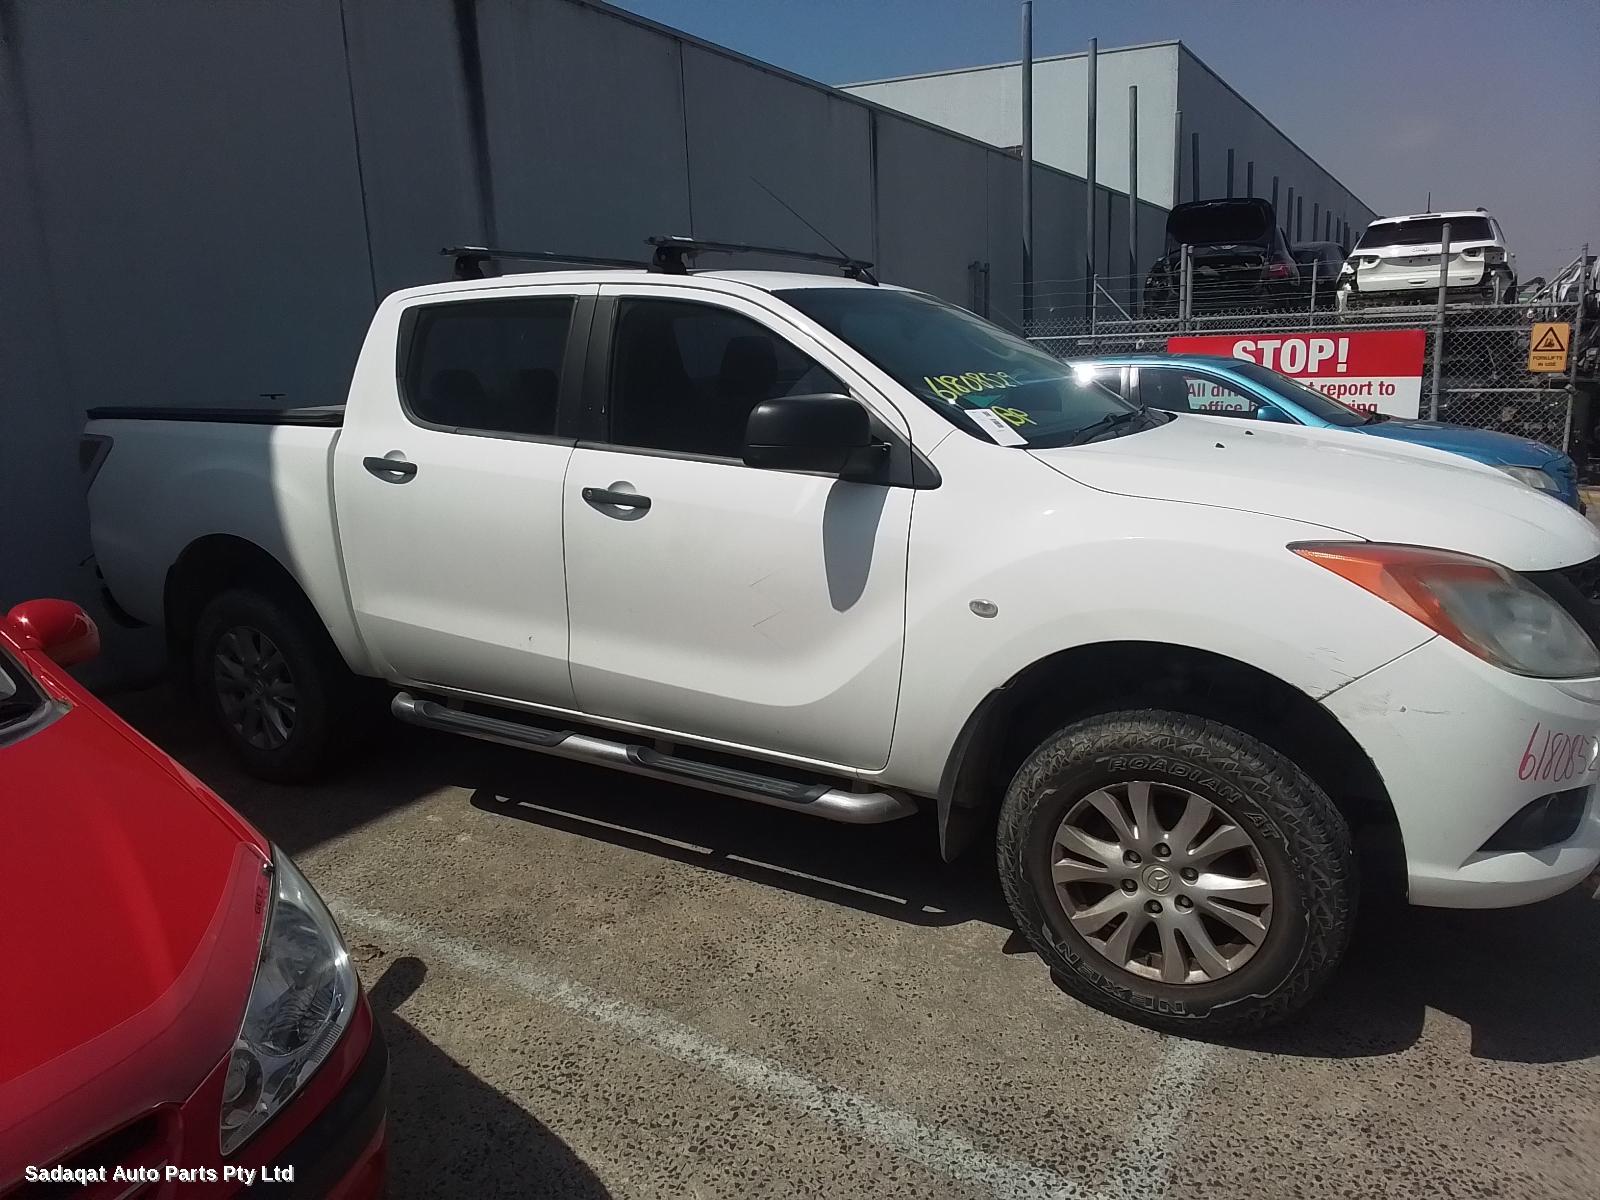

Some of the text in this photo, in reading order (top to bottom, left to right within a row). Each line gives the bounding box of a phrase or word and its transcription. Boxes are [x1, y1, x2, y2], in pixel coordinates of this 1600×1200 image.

[1232, 338, 1349, 374] STOP!
[1188, 383, 1206, 398] All
[1320, 381, 1374, 399] report
[1378, 381, 1396, 396] to
[1107, 756, 1242, 803] ROADIAN
[1055, 940, 1186, 1015] NEXEN
